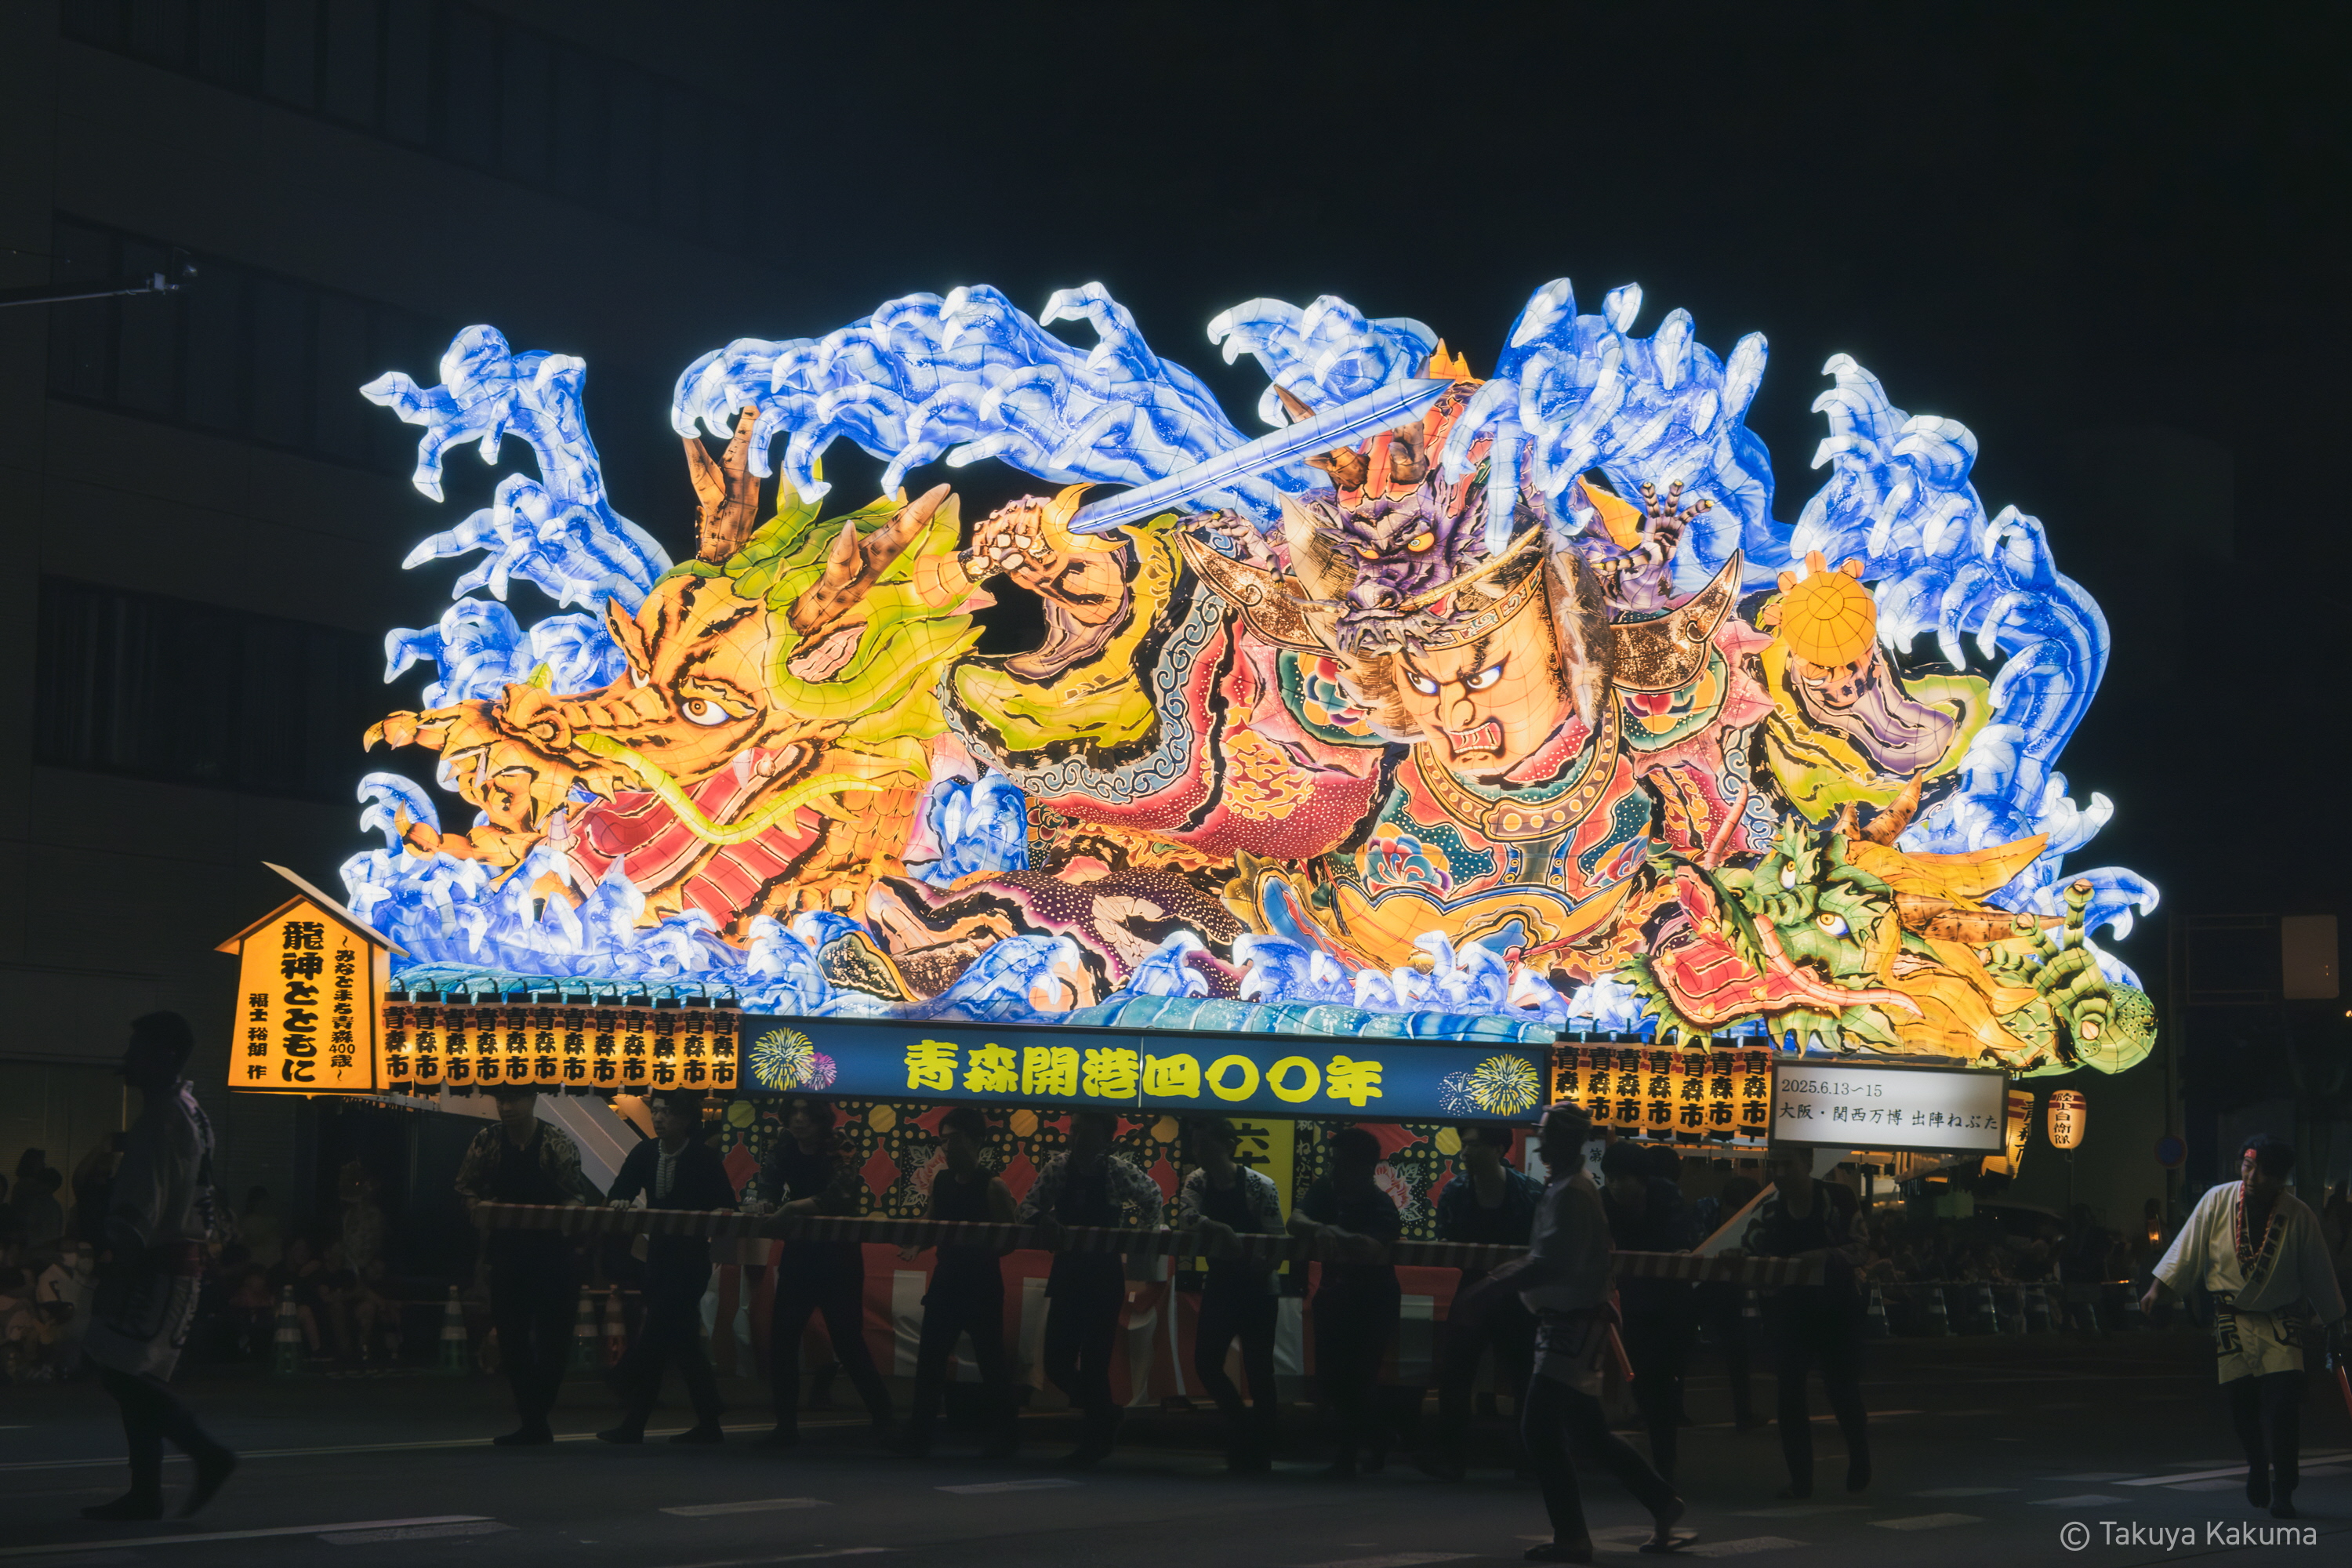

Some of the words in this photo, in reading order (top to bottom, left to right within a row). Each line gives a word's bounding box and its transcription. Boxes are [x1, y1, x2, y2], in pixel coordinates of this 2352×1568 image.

[249, 993, 268, 1022] 福士
[281, 921, 324, 1083] 龍神とともに
[247, 1065, 267, 1080] 作
[248, 1027, 267, 1057] 裕朗
[383, 1006, 408, 1078] 青森市
[414, 1006, 439, 1079] 青森市
[444, 1008, 470, 1080] 青森市
[475, 1007, 499, 1080] 青森市
[505, 1007, 529, 1080] 青森市
[534, 1007, 558, 1080] 青森市
[563, 1008, 587, 1081] 青森市
[593, 1009, 618, 1082] 青森市
[623, 1010, 648, 1081] 青森市
[652, 1011, 677, 1084] 青森市
[683, 1011, 707, 1083] 青森市
[712, 1011, 736, 1083] 青森市
[1554, 1045, 1580, 1103] 青森
[1587, 1047, 1611, 1121] 青森市
[1615, 1048, 1642, 1123] 青森市
[1647, 1050, 1673, 1125] 青森市
[1679, 1053, 1706, 1128] 青森市
[1709, 1051, 1736, 1126] 青森市
[1742, 1050, 1768, 1124] 青森市
[1779, 1102, 1904, 1127] 大阪・関西万博
[1911, 1109, 1999, 1131] 出陣ねぶた
